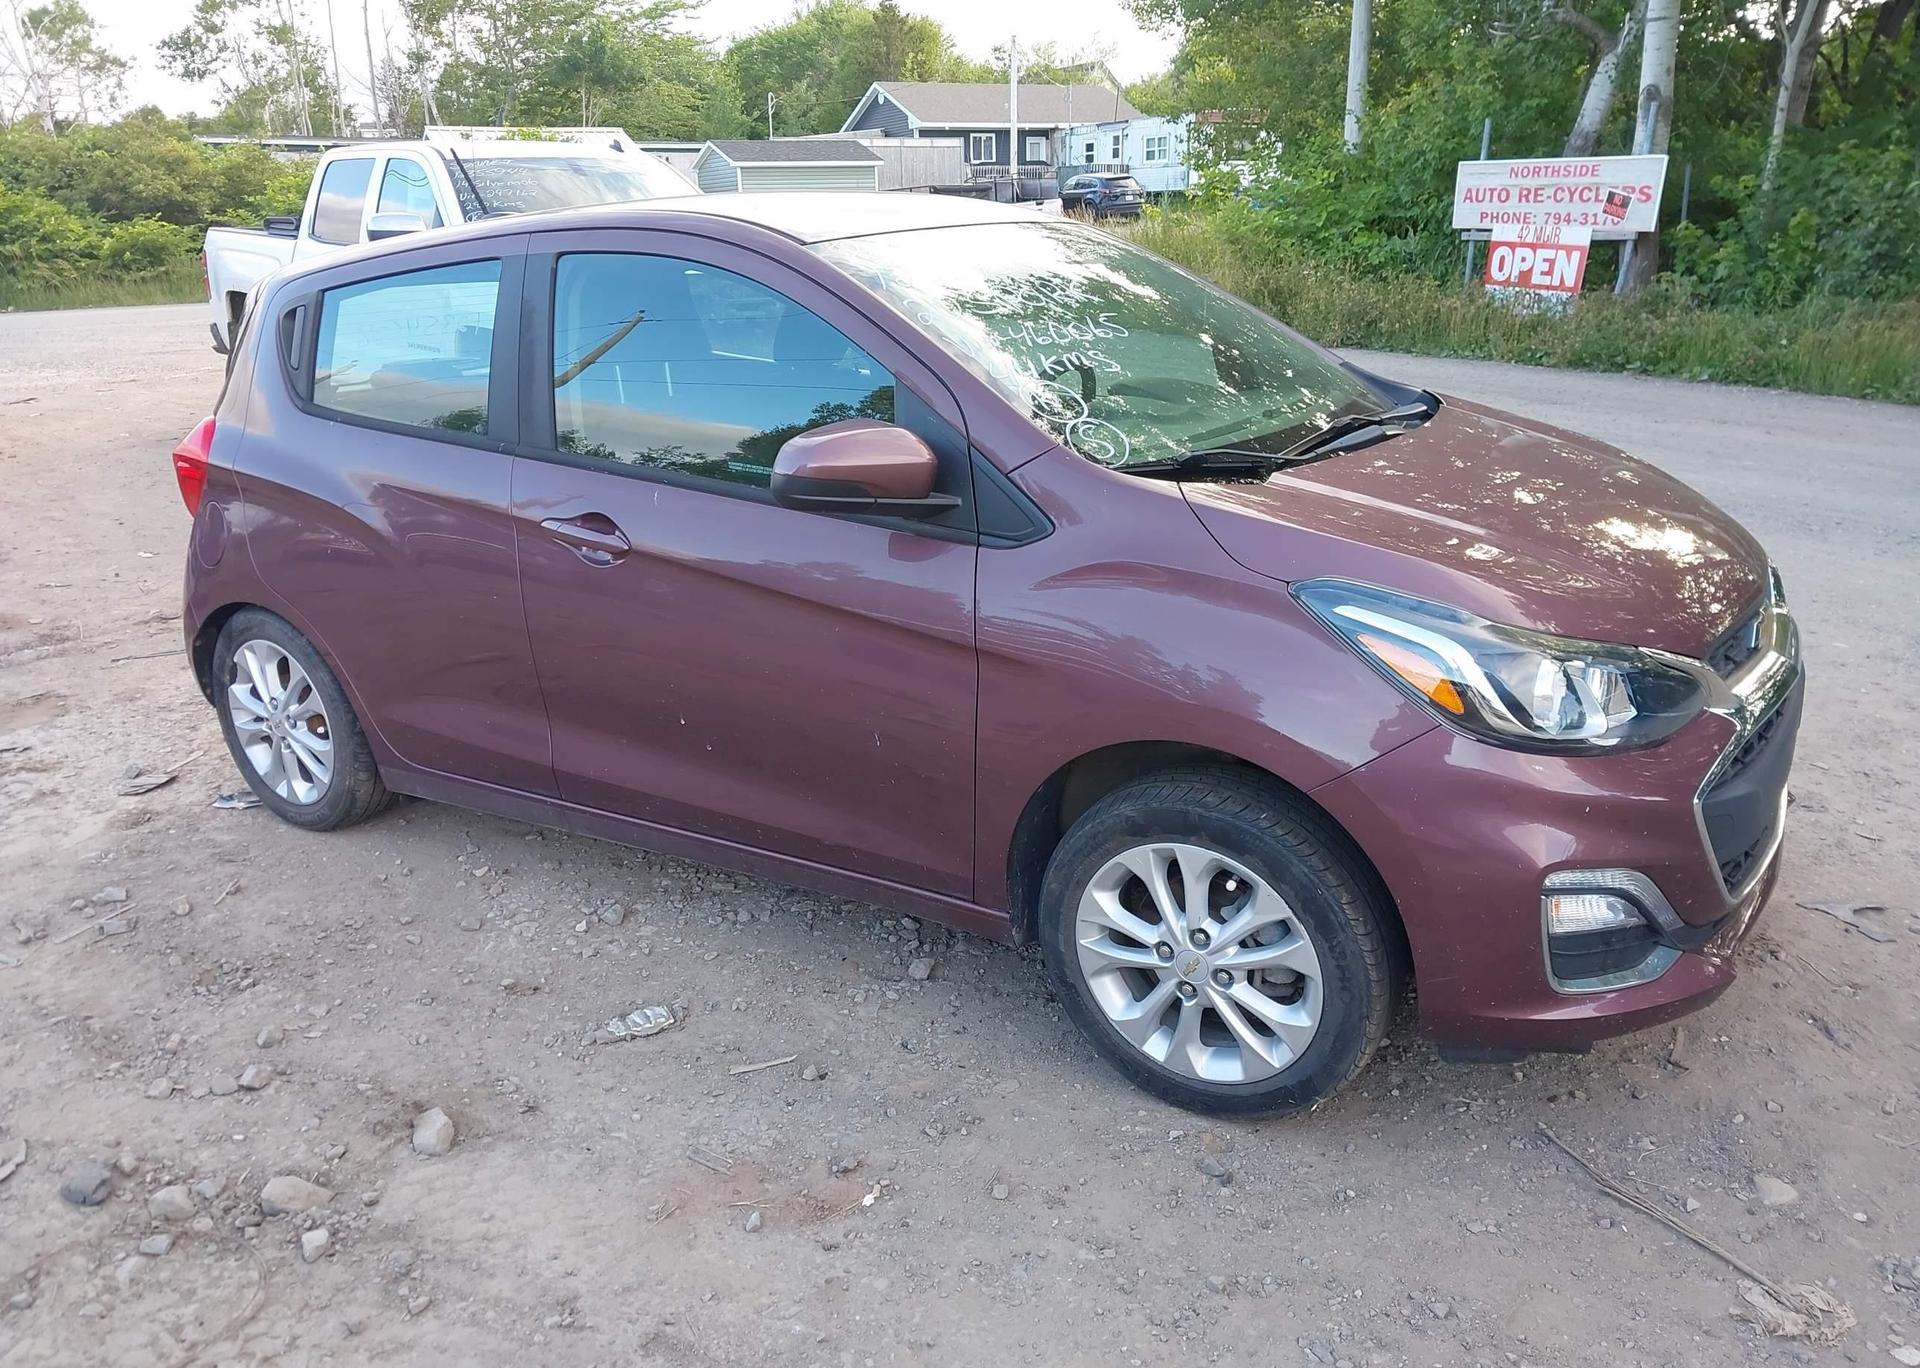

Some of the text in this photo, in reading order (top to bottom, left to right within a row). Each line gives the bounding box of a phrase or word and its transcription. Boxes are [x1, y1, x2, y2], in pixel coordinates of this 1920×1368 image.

[1509, 164, 1600, 179] NORTHSIDE
[1463, 185, 1653, 204] AUTO RE-CYCLS
[1479, 212, 1537, 225] PHONE:
[1517, 226, 1531, 242] 42
[1490, 246, 1581, 288] OPEN
